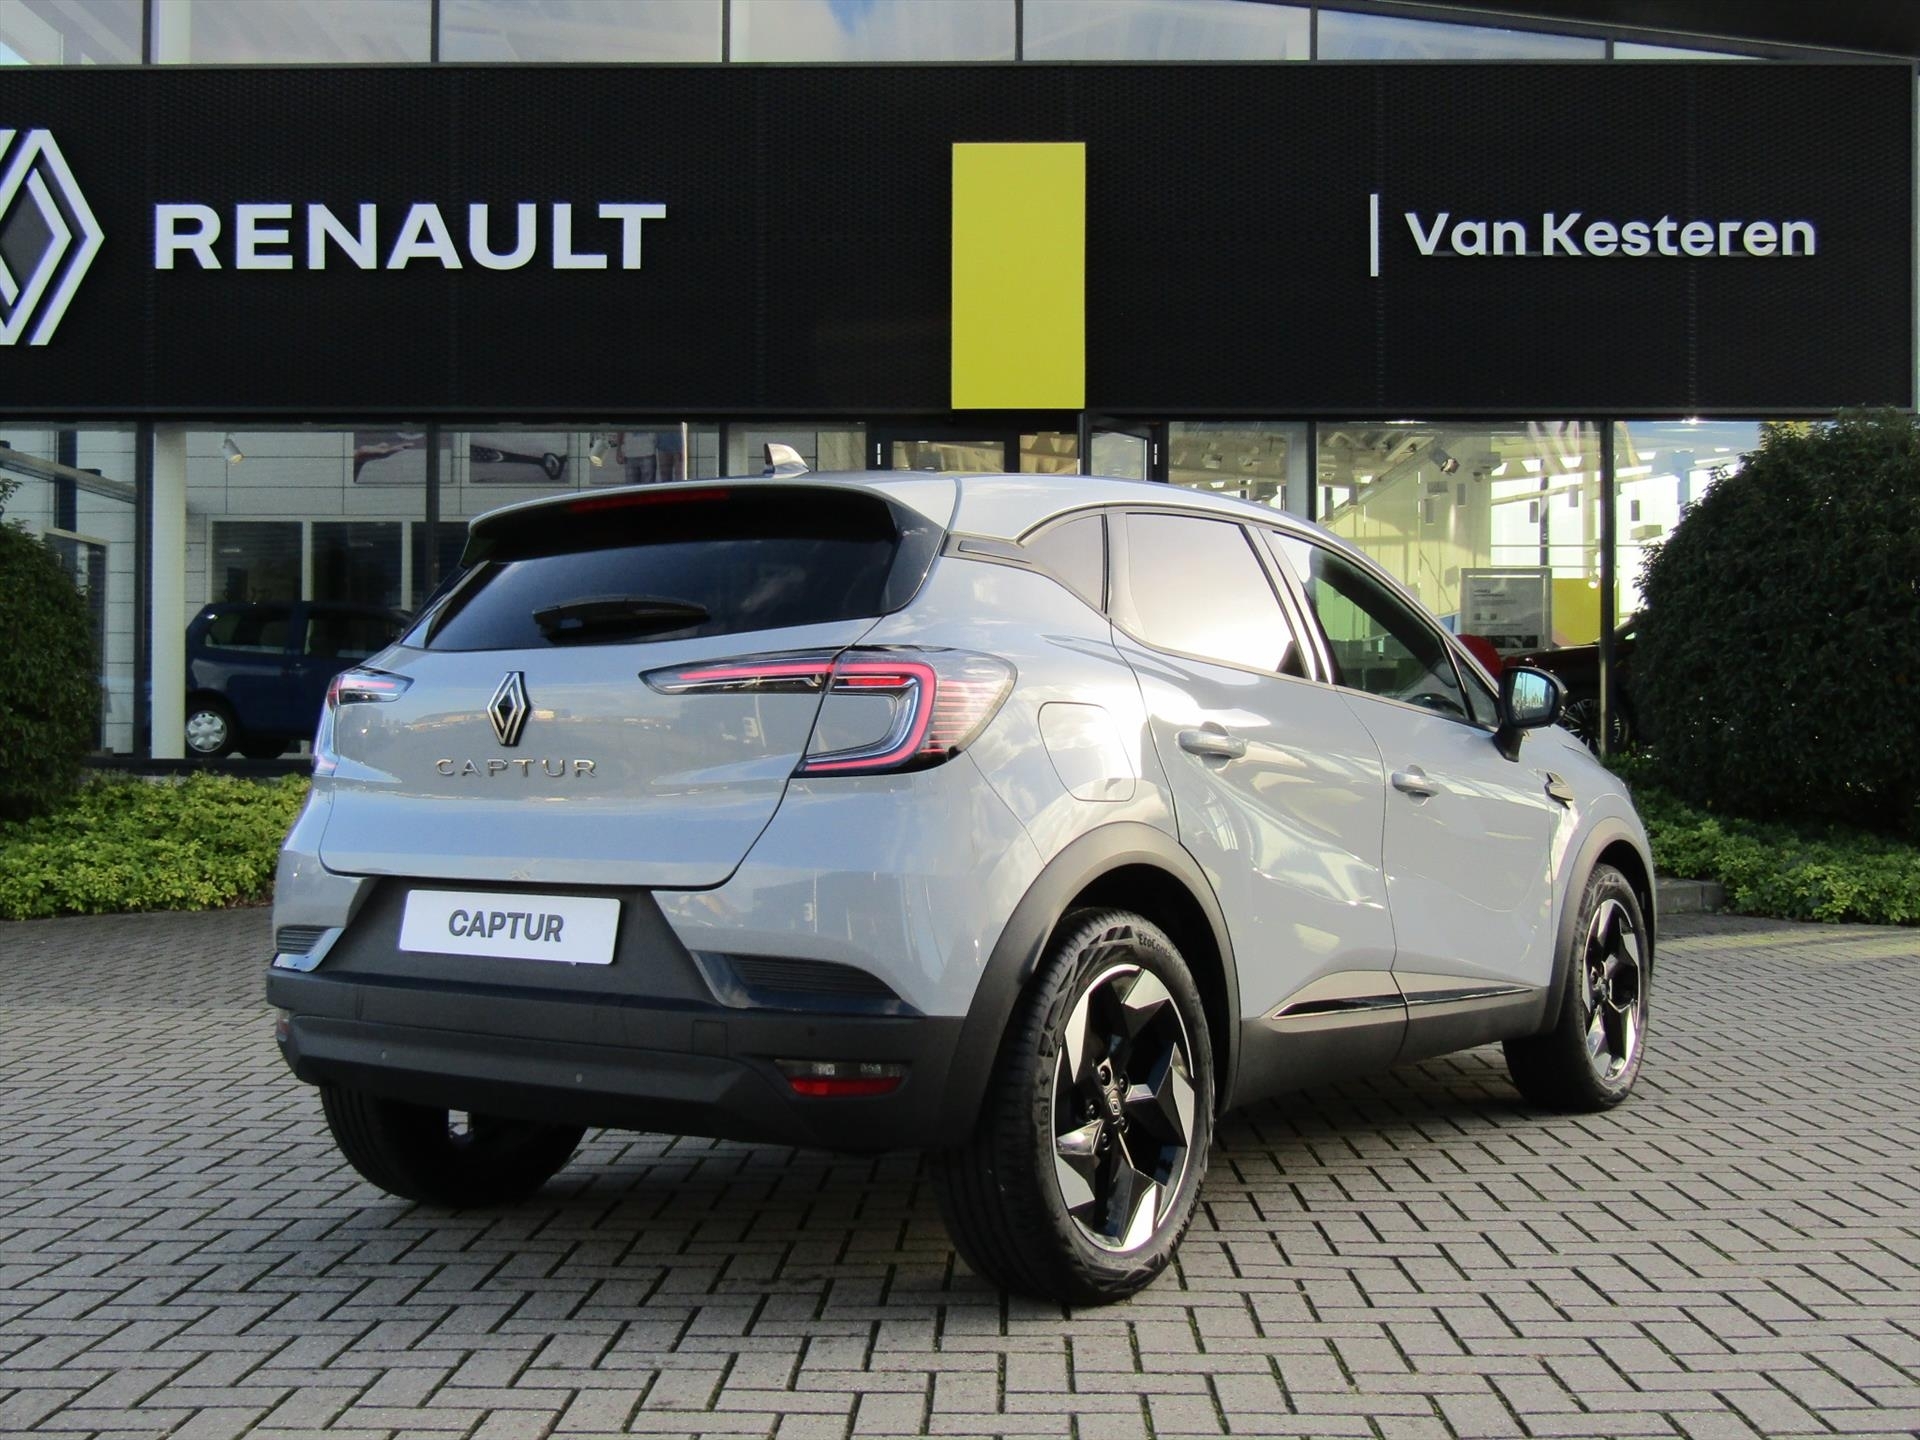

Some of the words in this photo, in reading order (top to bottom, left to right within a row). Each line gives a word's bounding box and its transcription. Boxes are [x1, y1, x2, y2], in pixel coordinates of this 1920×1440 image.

[154, 203, 667, 271] RENAULT
[1404, 212, 1527, 257] Van
[1542, 212, 1816, 258] Kesteren
[435, 758, 598, 778] CAPTUR
[447, 908, 565, 943] CAPTUR
